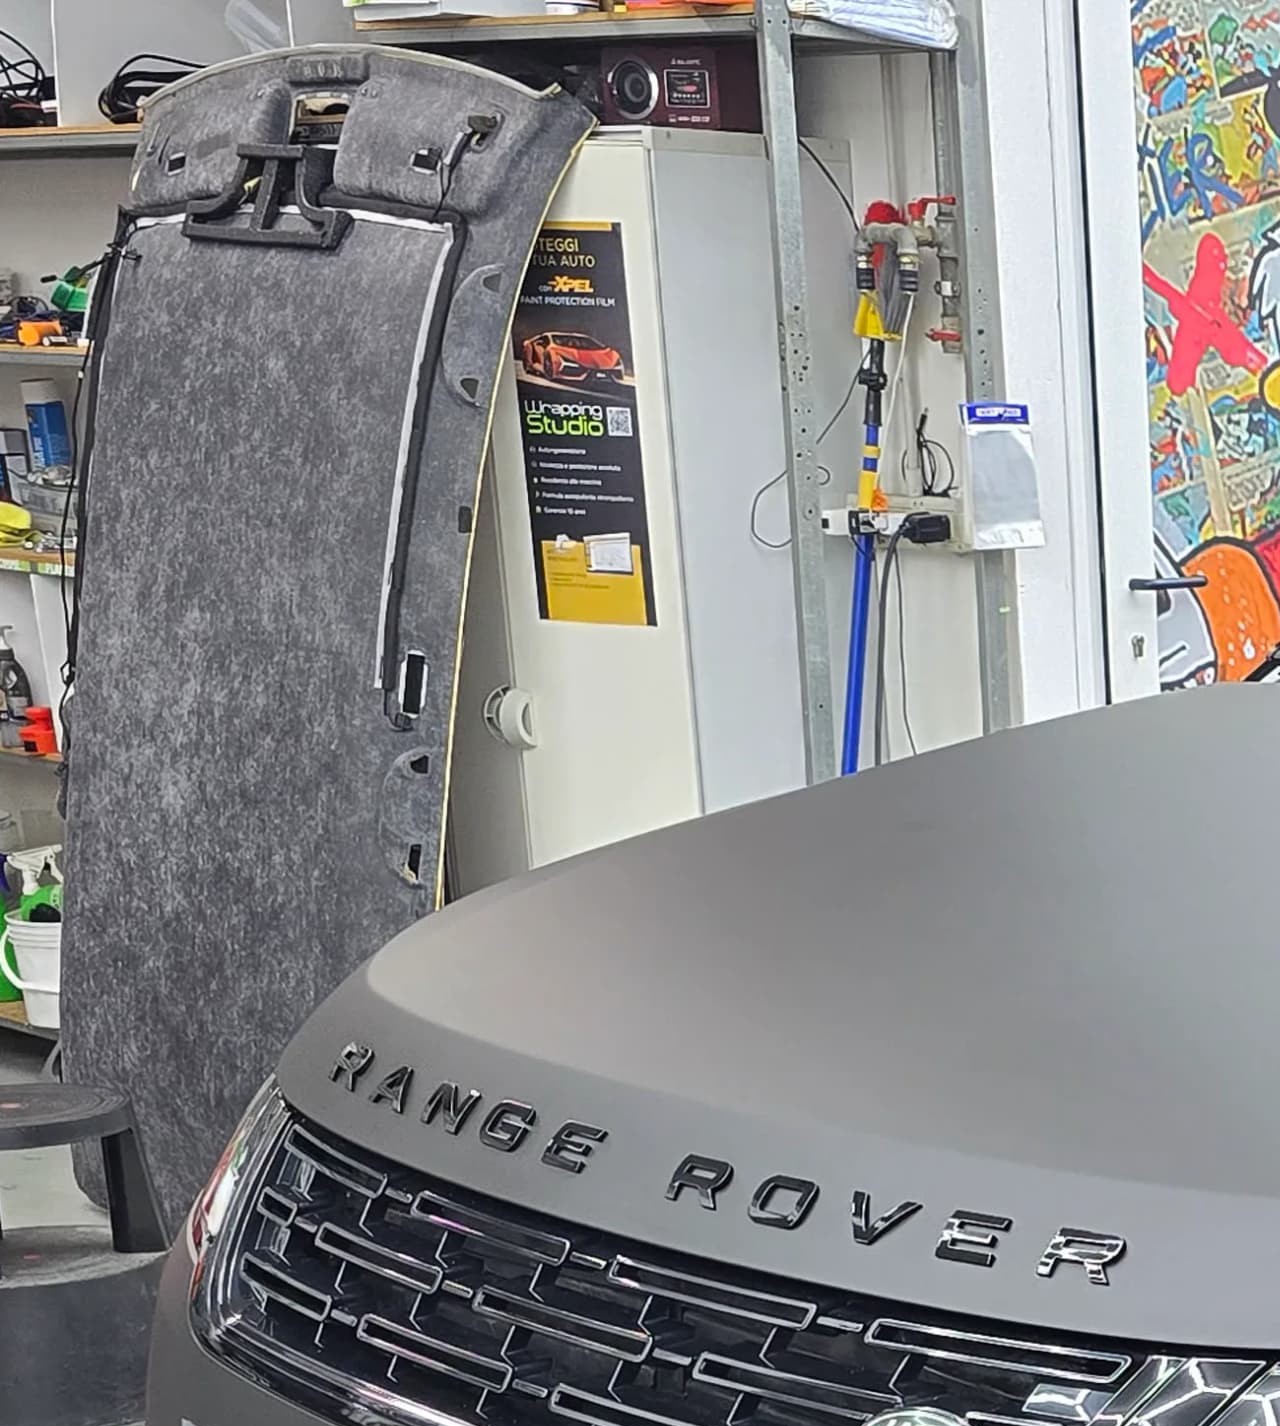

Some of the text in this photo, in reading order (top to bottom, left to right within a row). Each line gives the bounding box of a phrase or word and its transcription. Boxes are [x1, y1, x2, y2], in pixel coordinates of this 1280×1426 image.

[535, 238, 579, 252] TEGGI
[560, 255, 595, 267] AUTO
[549, 276, 594, 292] XPEL
[545, 296, 595, 306] PROTECTION
[596, 297, 615, 307] FILM
[525, 400, 603, 420] Wrapping
[526, 415, 604, 436] Studio
[328, 1041, 1127, 1286] RANGE ROVER
